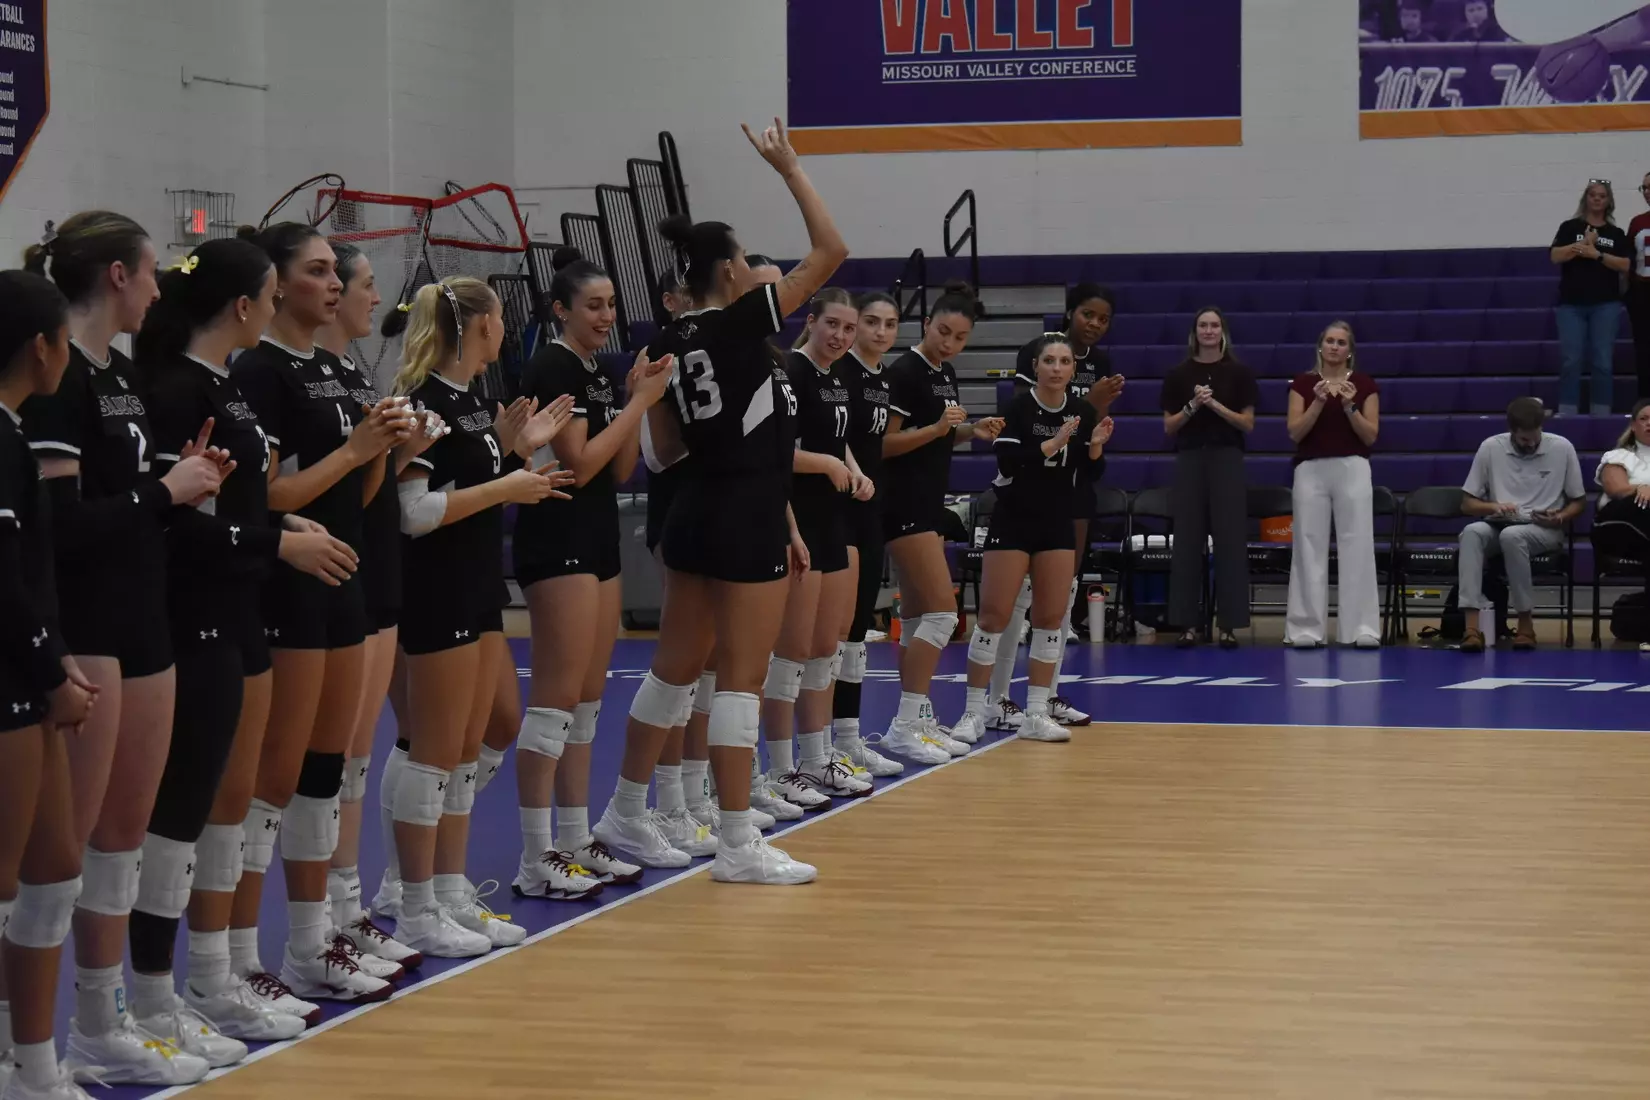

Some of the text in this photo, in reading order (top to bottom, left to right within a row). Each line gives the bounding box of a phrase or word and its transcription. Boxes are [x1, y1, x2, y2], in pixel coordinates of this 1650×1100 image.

[882, 59, 1137, 80] MISSOURI VALLEY CONFERENCE
[664, 349, 723, 425] 13
[780, 383, 798, 416] 15
[834, 405, 849, 438] 17
[867, 406, 888, 435] 18
[127, 421, 151, 473] 2
[483, 433, 501, 475] 9
